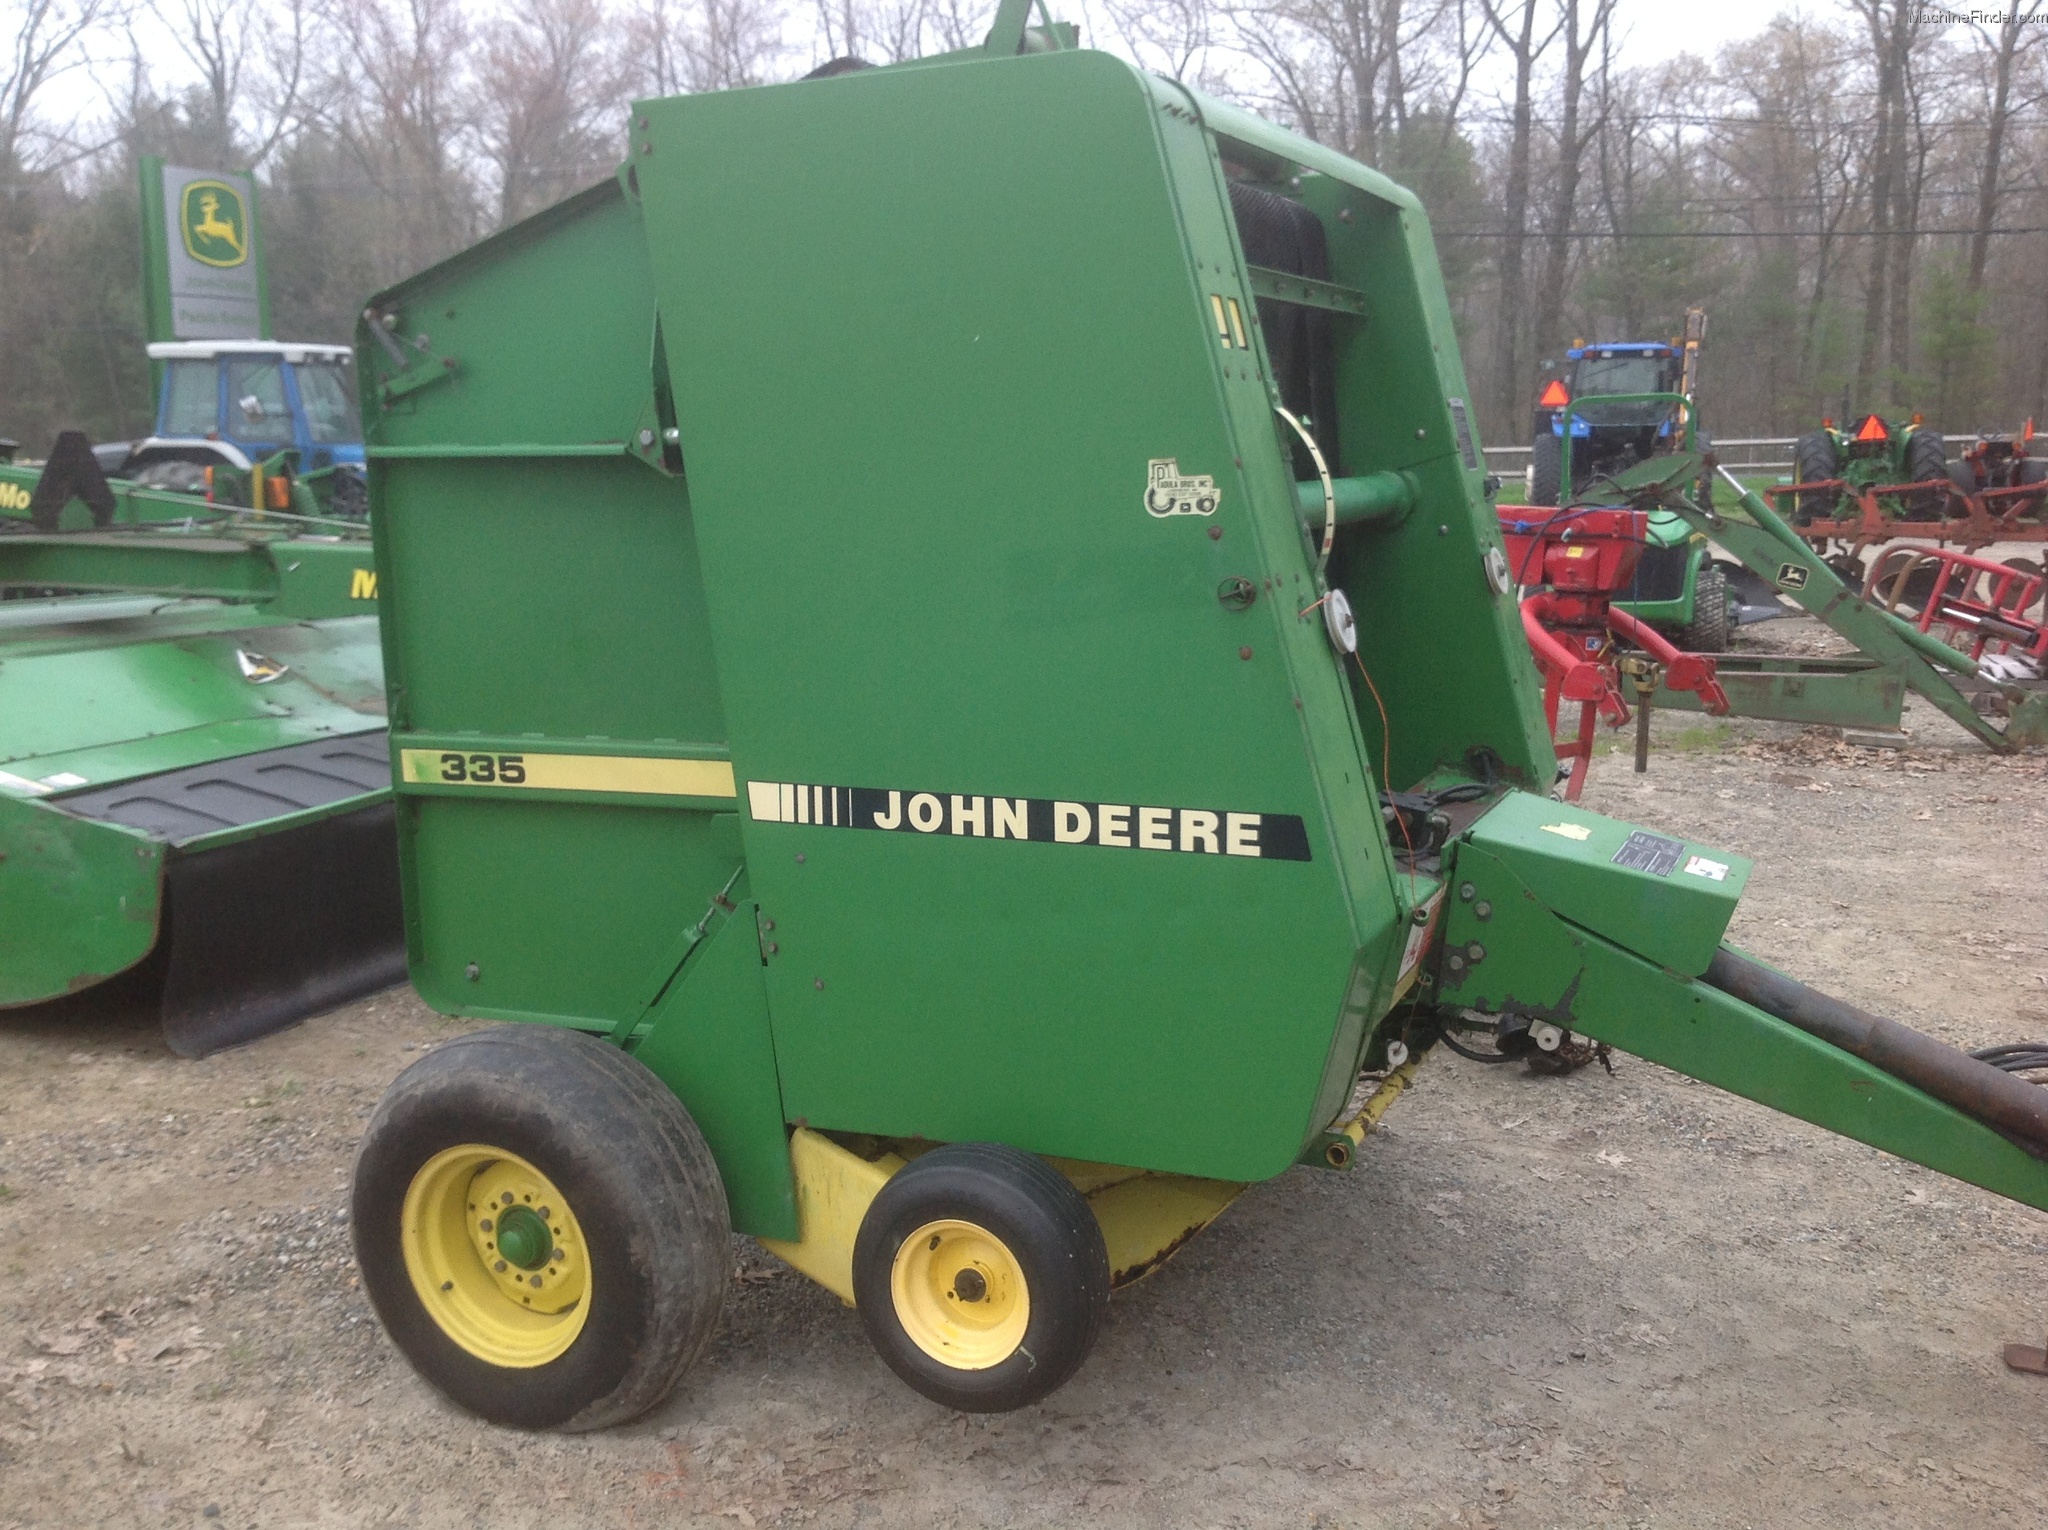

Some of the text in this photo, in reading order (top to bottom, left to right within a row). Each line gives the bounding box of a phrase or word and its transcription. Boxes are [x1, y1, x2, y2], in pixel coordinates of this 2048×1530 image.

[441, 753, 526, 784] 335
[873, 790, 1261, 857] JOHN DEERE
